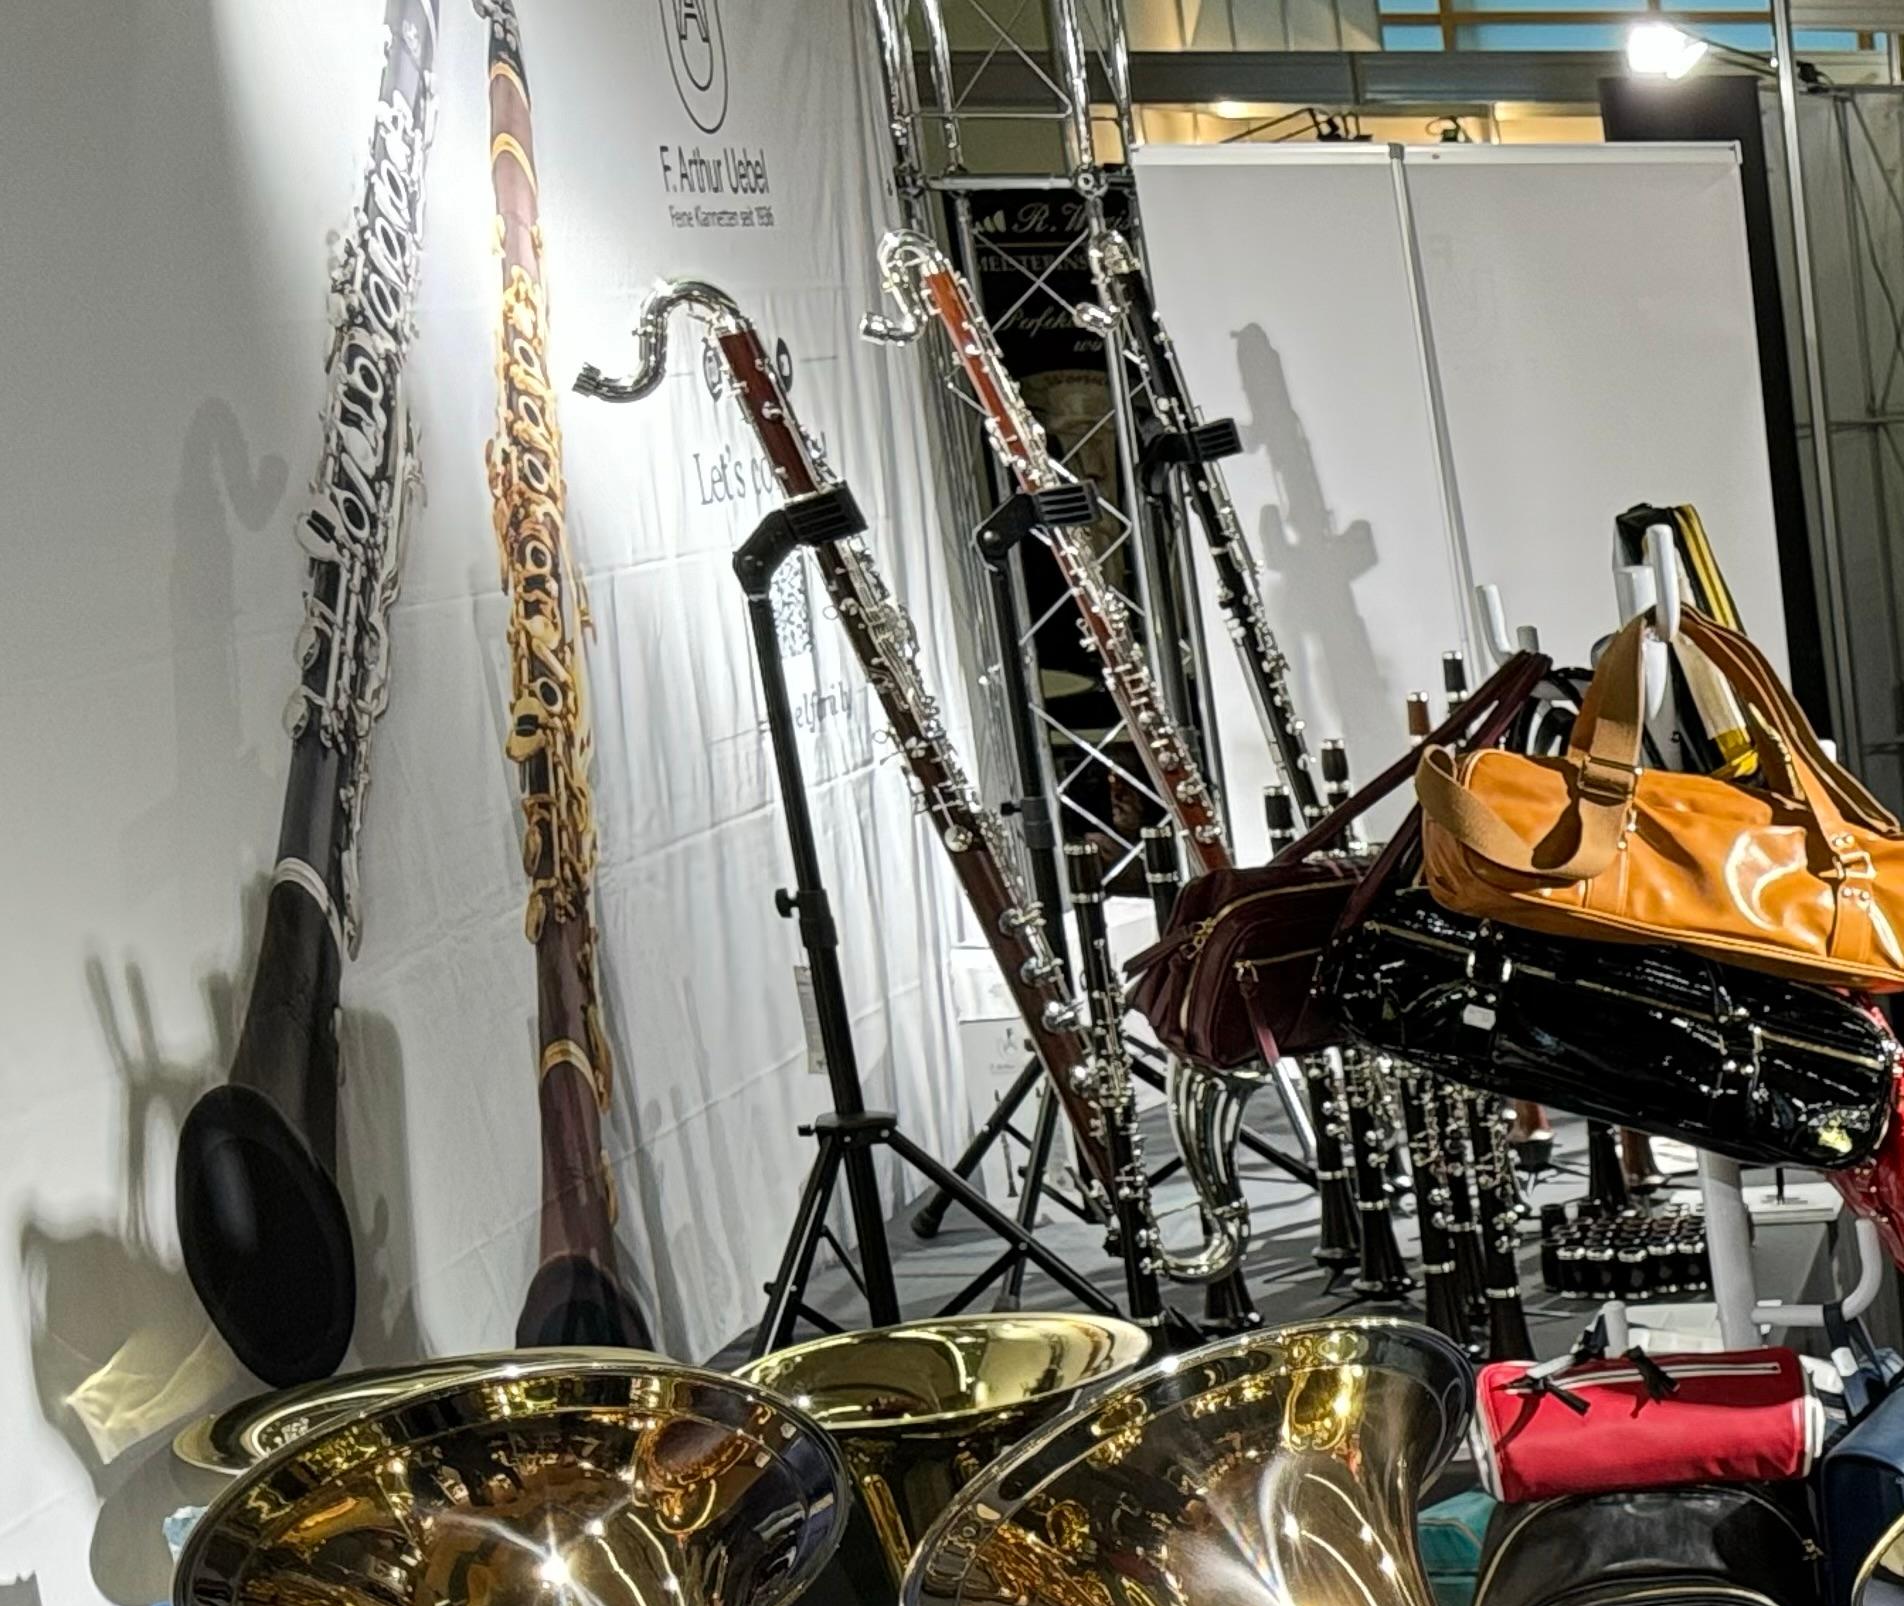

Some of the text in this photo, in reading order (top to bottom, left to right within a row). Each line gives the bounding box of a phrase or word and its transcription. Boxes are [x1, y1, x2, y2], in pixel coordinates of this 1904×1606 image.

[678, 145, 724, 193] Arthur
[723, 147, 770, 194] Uebel
[692, 444, 748, 506] Let's
